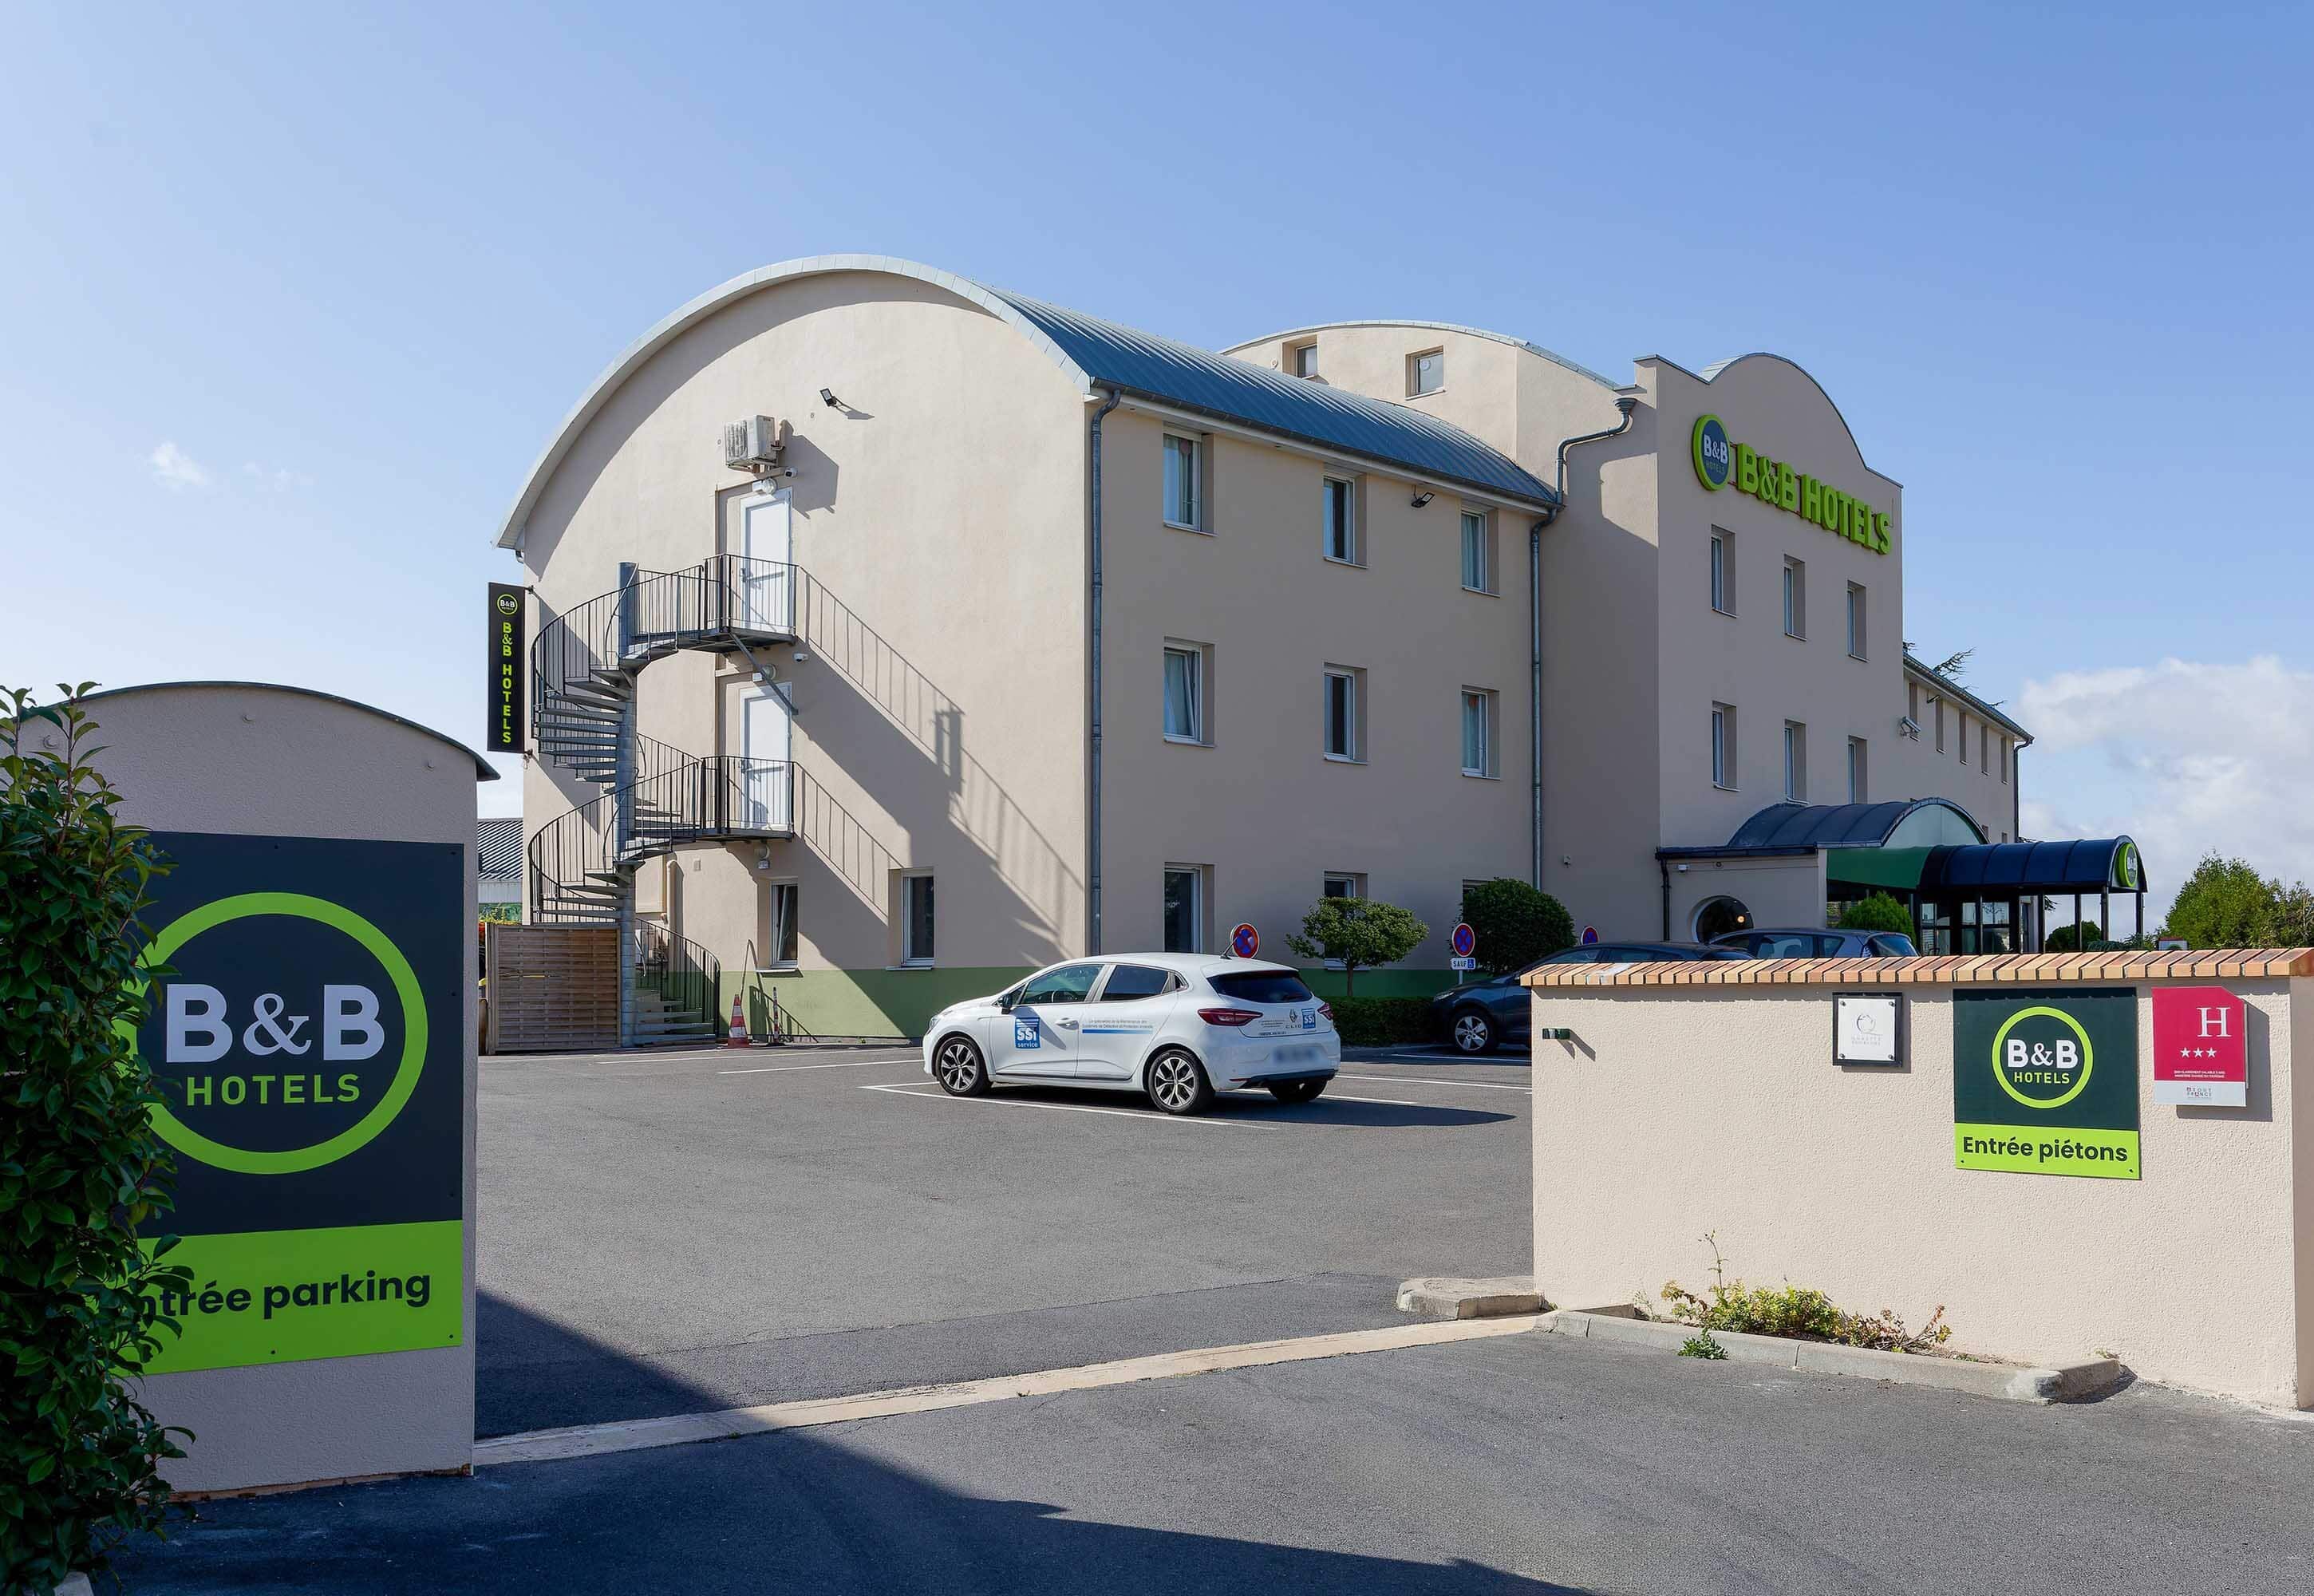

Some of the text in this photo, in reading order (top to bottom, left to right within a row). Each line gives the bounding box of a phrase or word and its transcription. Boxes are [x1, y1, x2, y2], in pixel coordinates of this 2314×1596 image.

[1704, 434, 1728, 464] B&B
[1736, 443, 1891, 555] B&B HOTELS
[502, 622, 513, 656] B&B
[502, 664, 512, 744] HOTELS
[166, 984, 385, 1063] B&B
[2196, 1007, 2232, 1037] H
[2007, 1039, 2079, 1069] B&B
[186, 1074, 360, 1106] HOTELS
[2014, 1072, 2071, 1084] HOTELS
[1963, 1136, 2128, 1163] Entrée piétons
[137, 1270, 430, 1320] ntrée parking
